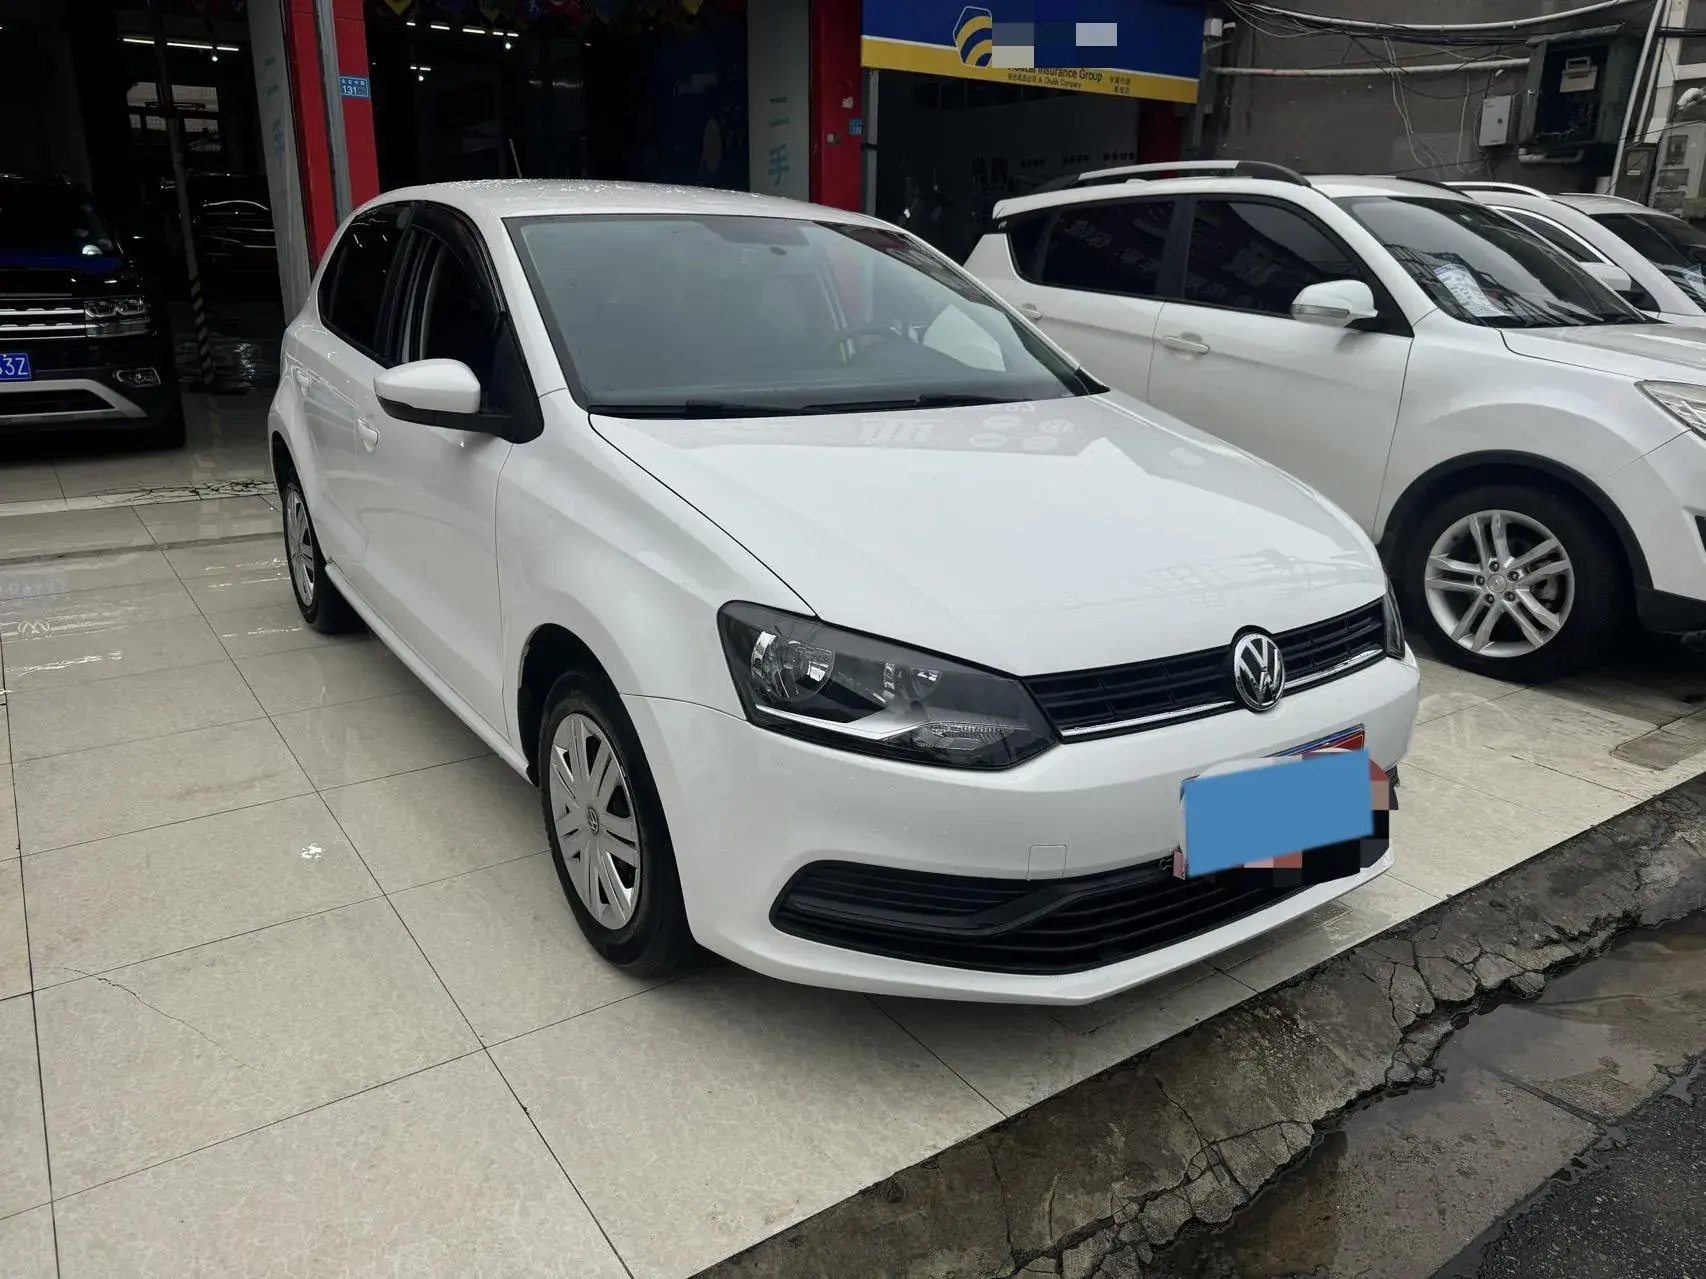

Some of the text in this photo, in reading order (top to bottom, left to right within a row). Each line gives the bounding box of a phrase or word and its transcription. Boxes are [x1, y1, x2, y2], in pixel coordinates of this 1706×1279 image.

[1039, 67, 1077, 78] Insurance
[1079, 69, 1103, 83] Group
[0, 357, 28, 375] 3Z
